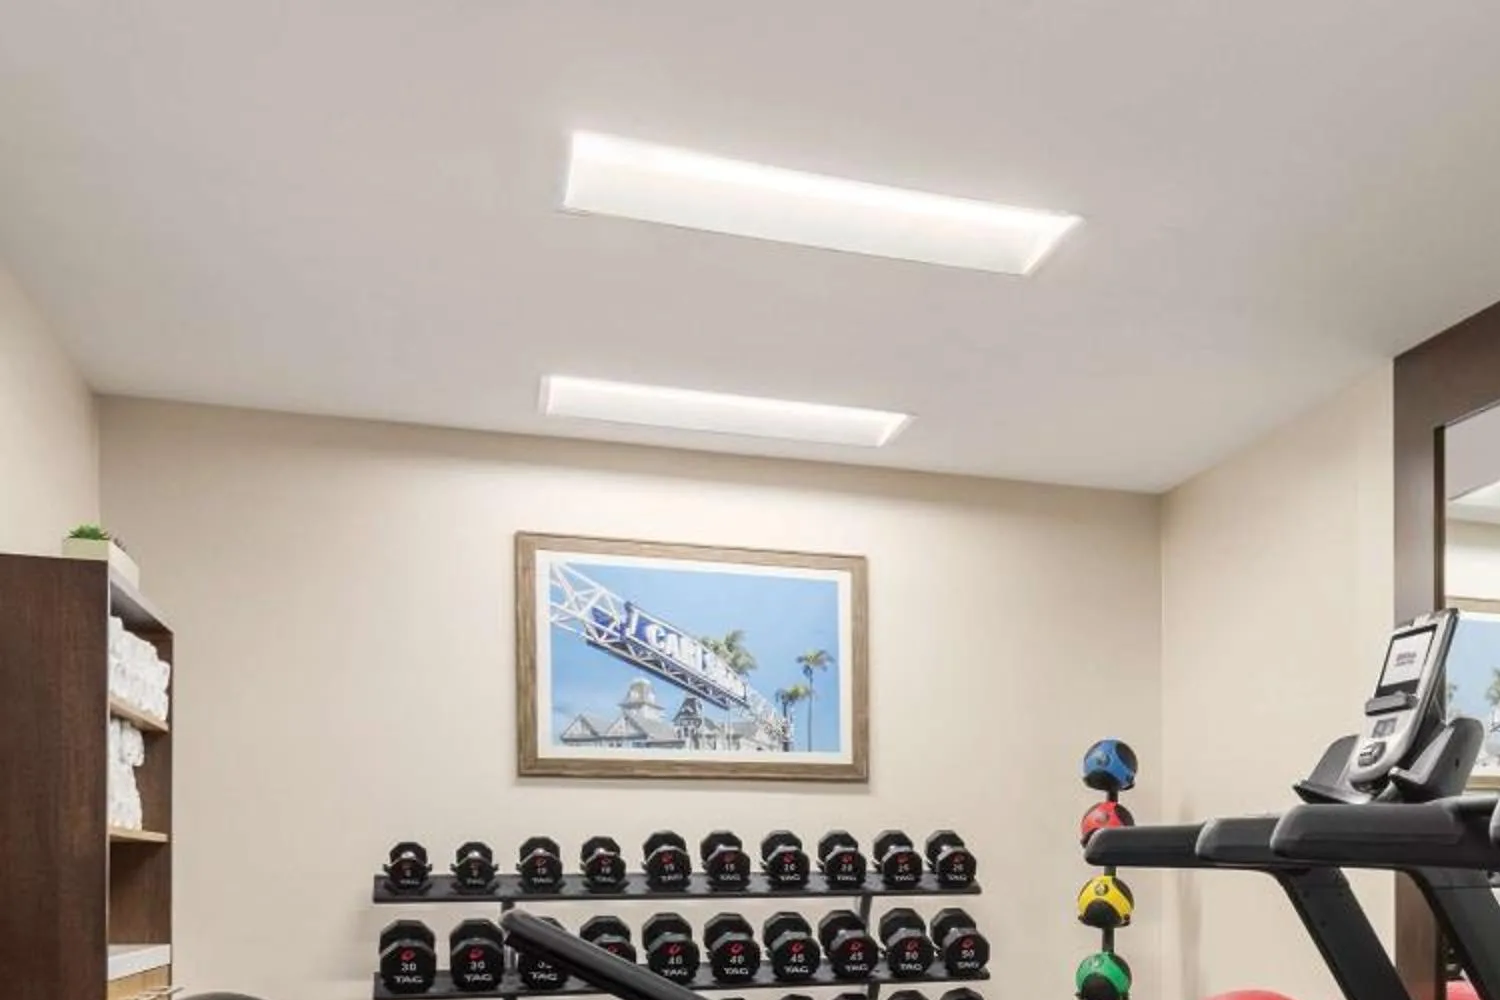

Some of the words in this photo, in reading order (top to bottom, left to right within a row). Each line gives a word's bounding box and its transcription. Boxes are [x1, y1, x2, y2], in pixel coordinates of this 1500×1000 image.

[784, 965, 809, 973] TAG
[394, 975, 424, 983] TAG
[464, 974, 493, 982] TAG
[529, 972, 558, 981] TAG
